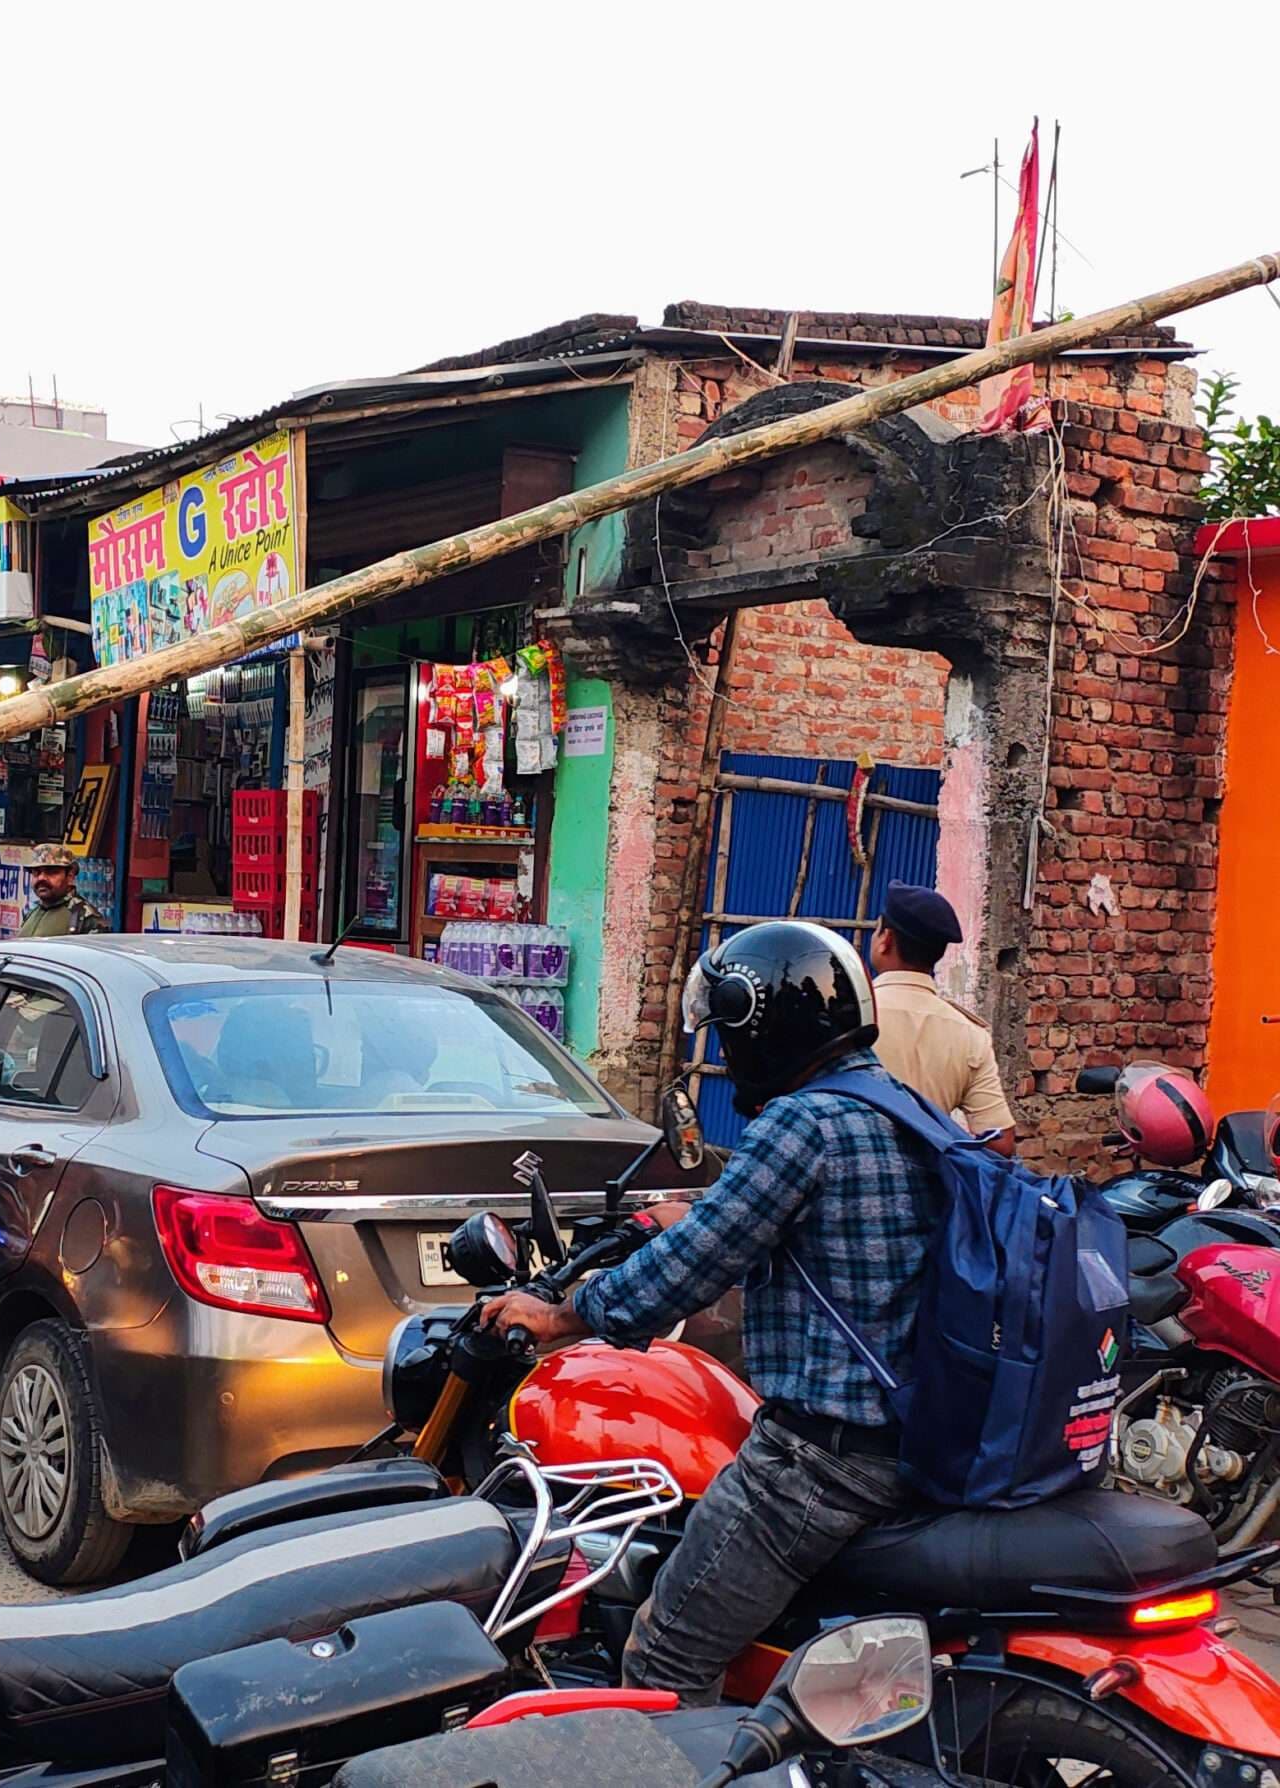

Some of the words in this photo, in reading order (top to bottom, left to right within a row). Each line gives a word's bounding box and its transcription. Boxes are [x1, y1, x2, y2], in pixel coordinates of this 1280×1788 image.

[90, 517, 165, 592] मौसम
[179, 486, 207, 558] G
[219, 450, 288, 541] स्टोर
[208, 546, 218, 575] A
[220, 540, 251, 570] Unice
[280, 1180, 360, 1192] DZIRE
[425, 1253, 439, 1262] IND
